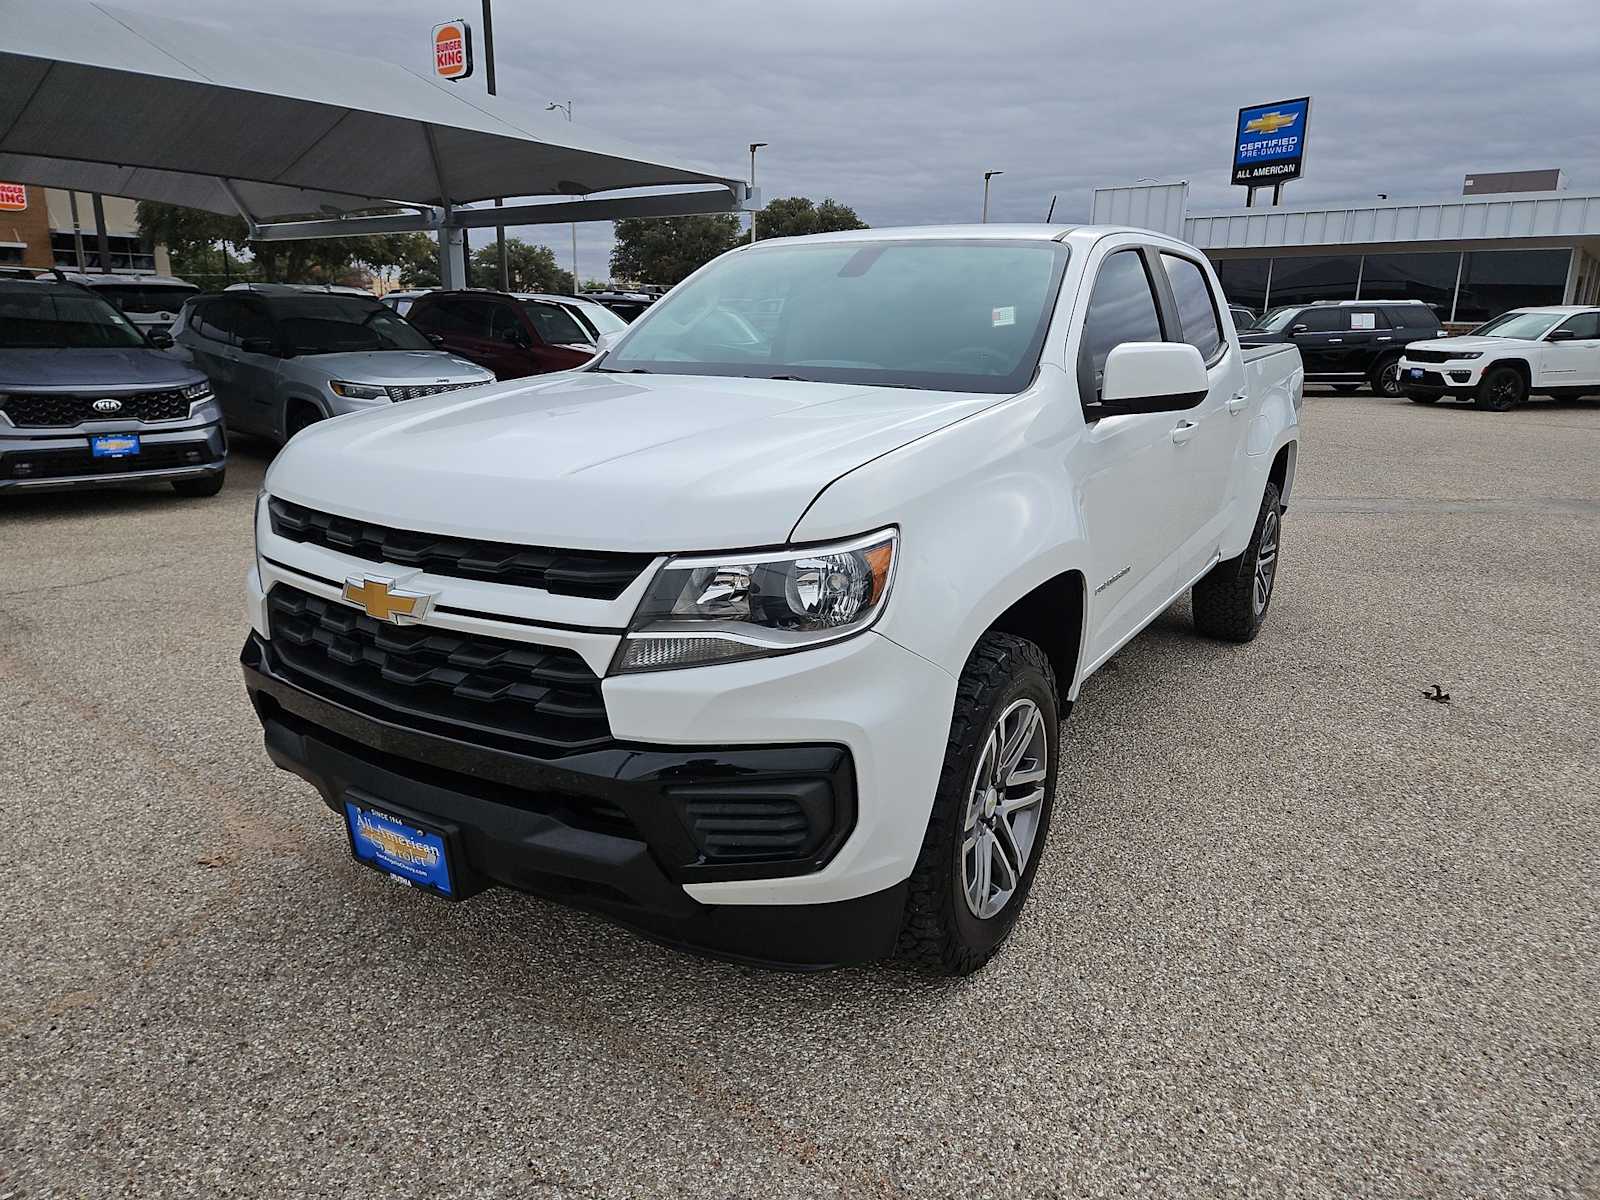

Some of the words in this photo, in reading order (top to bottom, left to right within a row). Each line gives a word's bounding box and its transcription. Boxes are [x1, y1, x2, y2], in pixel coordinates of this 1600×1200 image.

[436, 40, 462, 53] BURGER
[437, 50, 462, 67] KING
[1240, 136, 1298, 151] CERTIFIED
[1241, 145, 1294, 158] PRE-OWNED
[1236, 169, 1251, 179] ALL
[1252, 164, 1295, 177] AMERICAN
